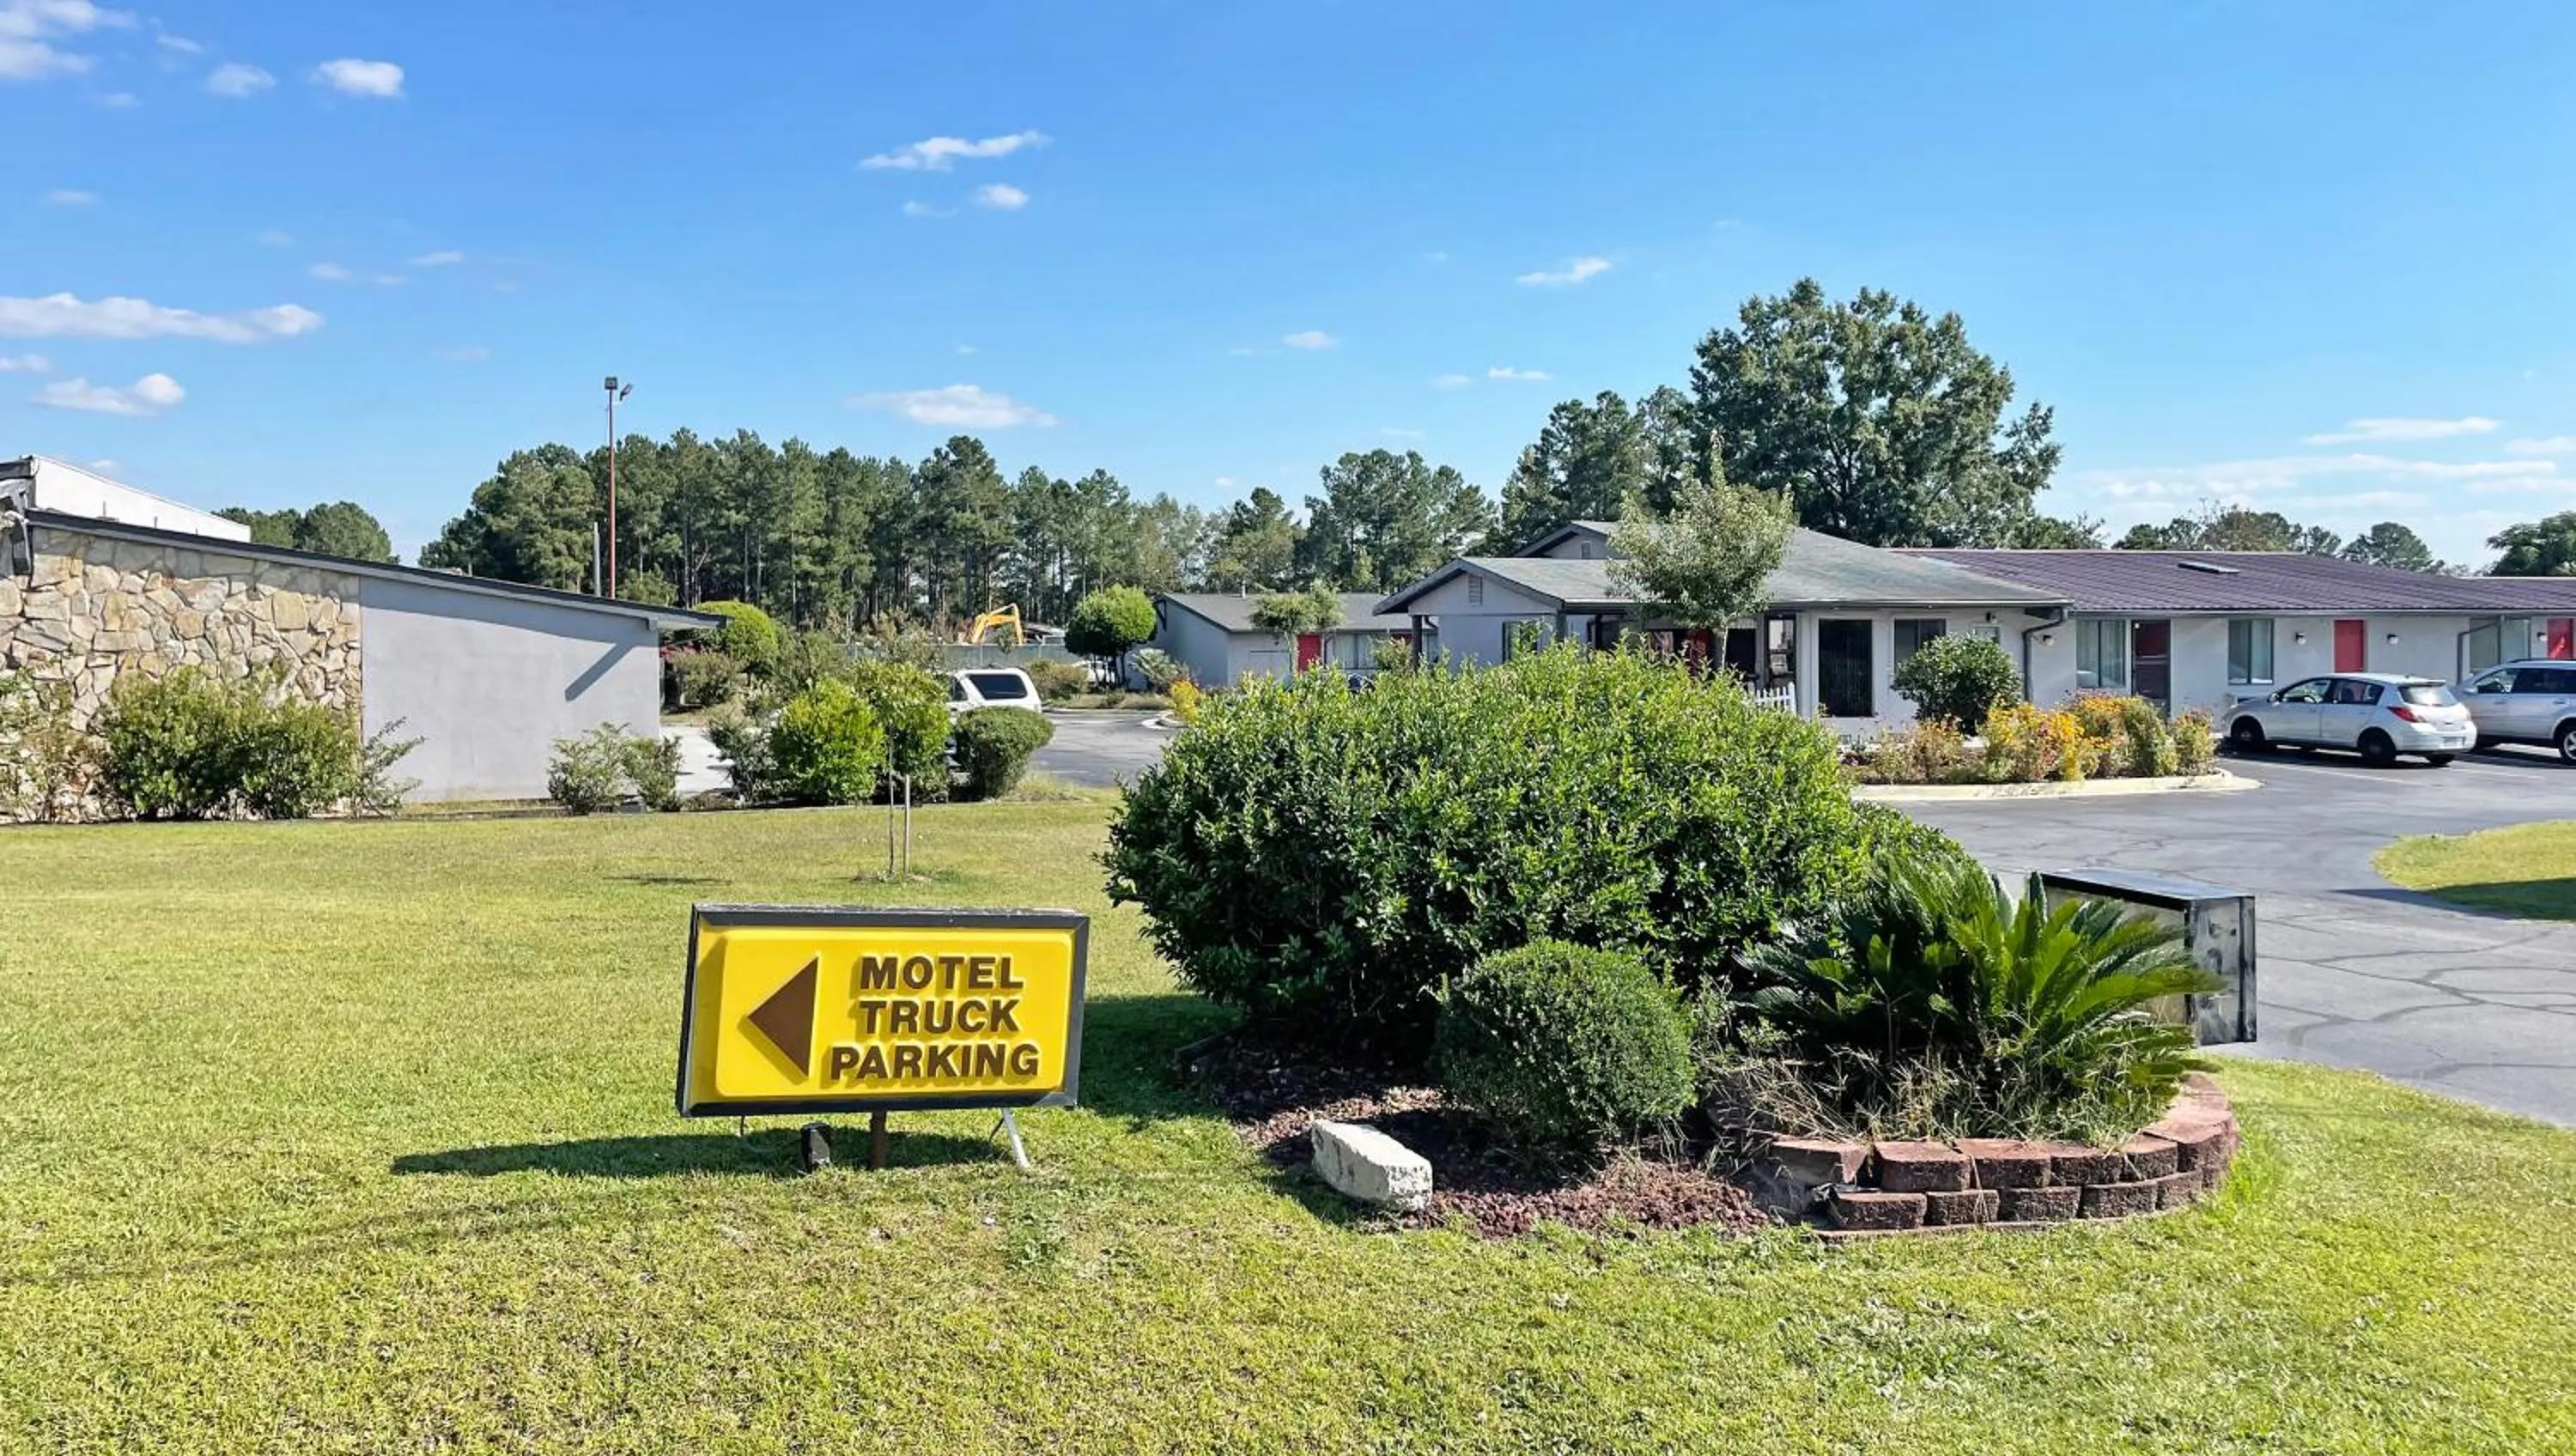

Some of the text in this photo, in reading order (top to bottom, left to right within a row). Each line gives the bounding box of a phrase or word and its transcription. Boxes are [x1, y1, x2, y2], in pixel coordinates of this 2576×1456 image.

[860, 956, 1024, 990] MOTEL
[859, 998, 1020, 1034] TRUCK
[830, 1043, 1040, 1080] PARKING
